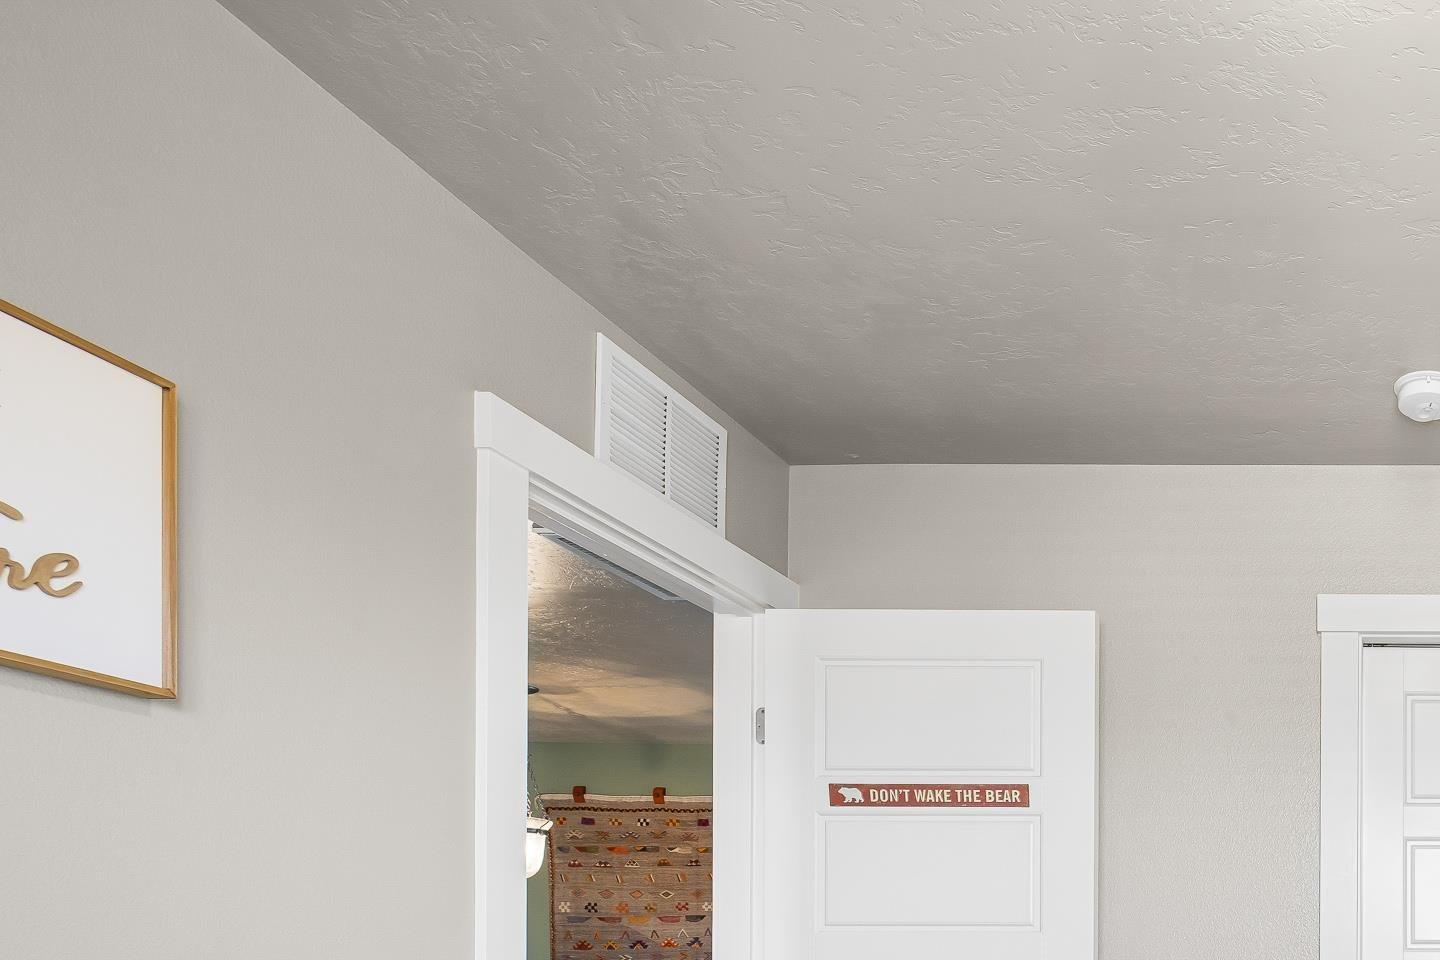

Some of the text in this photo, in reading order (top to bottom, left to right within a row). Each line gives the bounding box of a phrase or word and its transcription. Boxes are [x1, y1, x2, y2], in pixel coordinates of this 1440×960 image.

[870, 788, 1021, 803] DON'T WAKE THE BEAR
